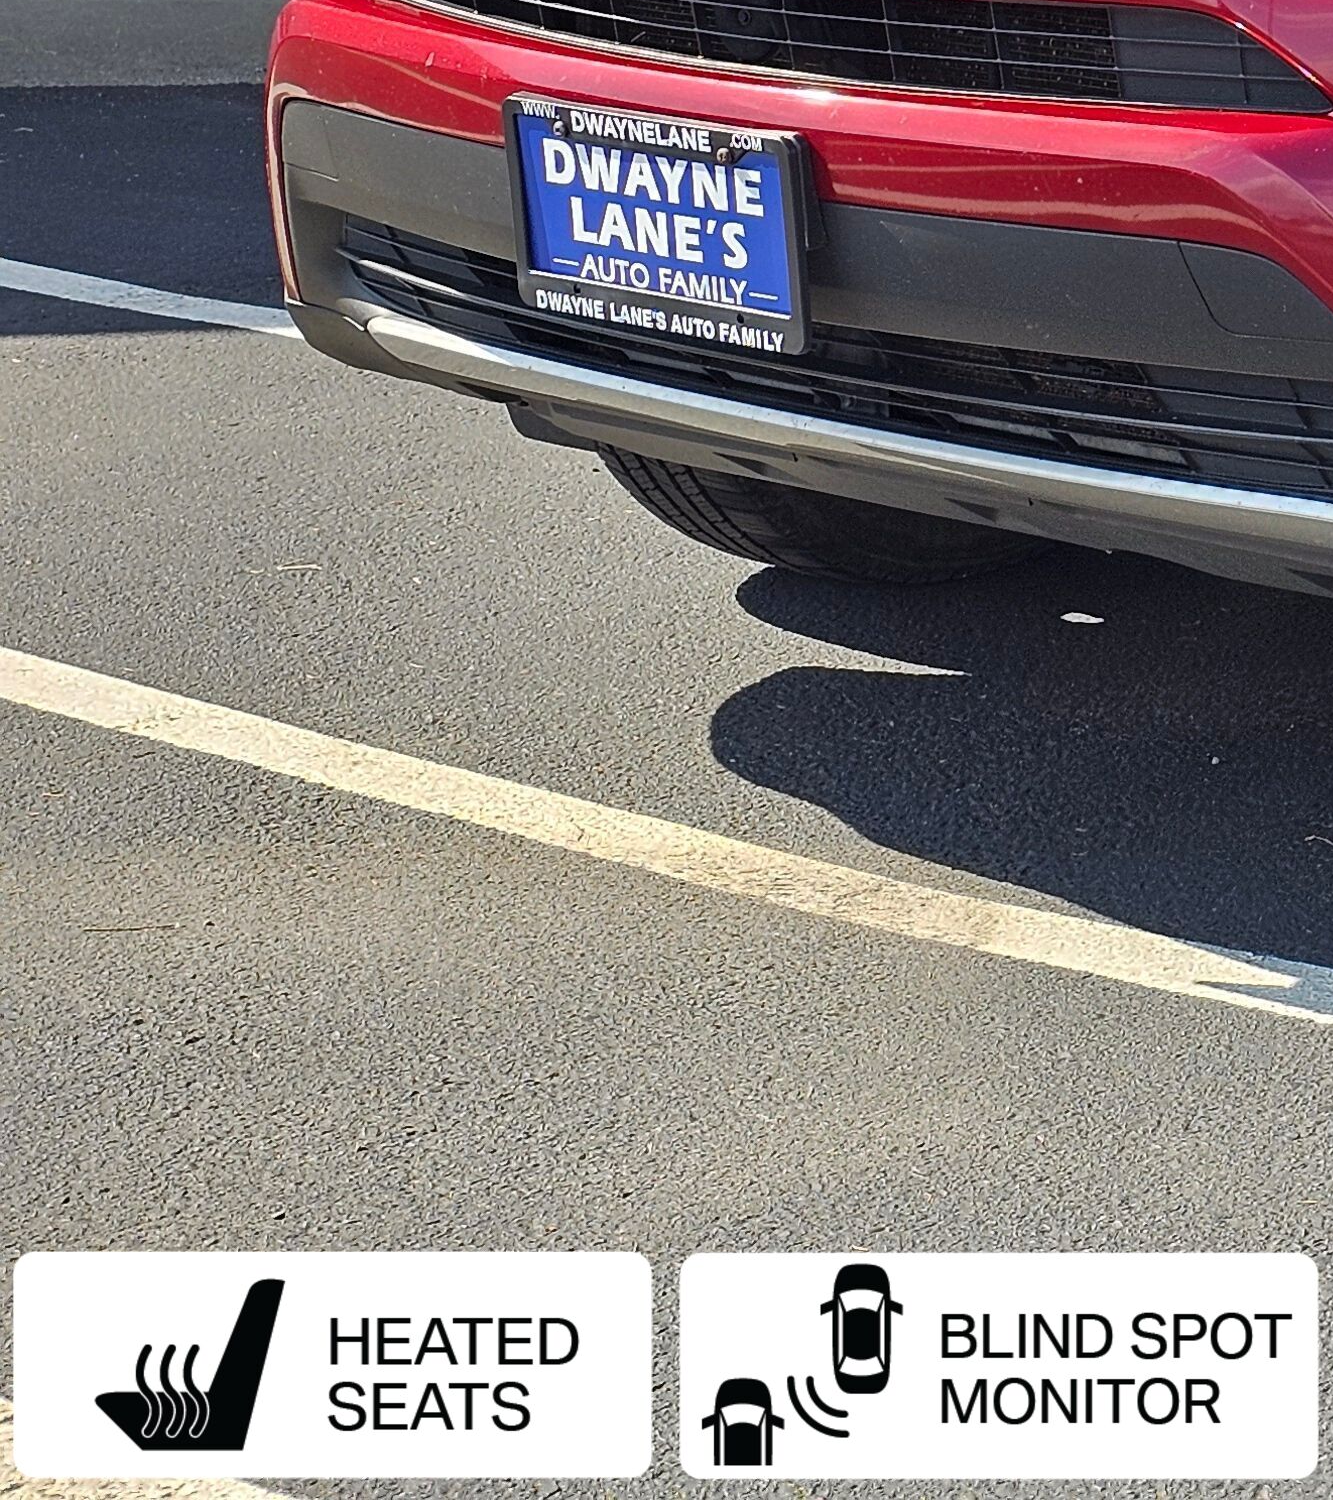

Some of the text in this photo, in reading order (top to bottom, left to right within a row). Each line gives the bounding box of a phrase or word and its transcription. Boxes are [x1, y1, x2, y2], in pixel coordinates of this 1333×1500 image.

[570, 110, 712, 153] DWAYNELANE
[542, 137, 765, 218] DWAYNE
[569, 195, 749, 270] LANE'S
[580, 253, 749, 306] AUTO FAMILY
[535, 288, 785, 354] DWAYNE LANE'S AUTO FAMILY
